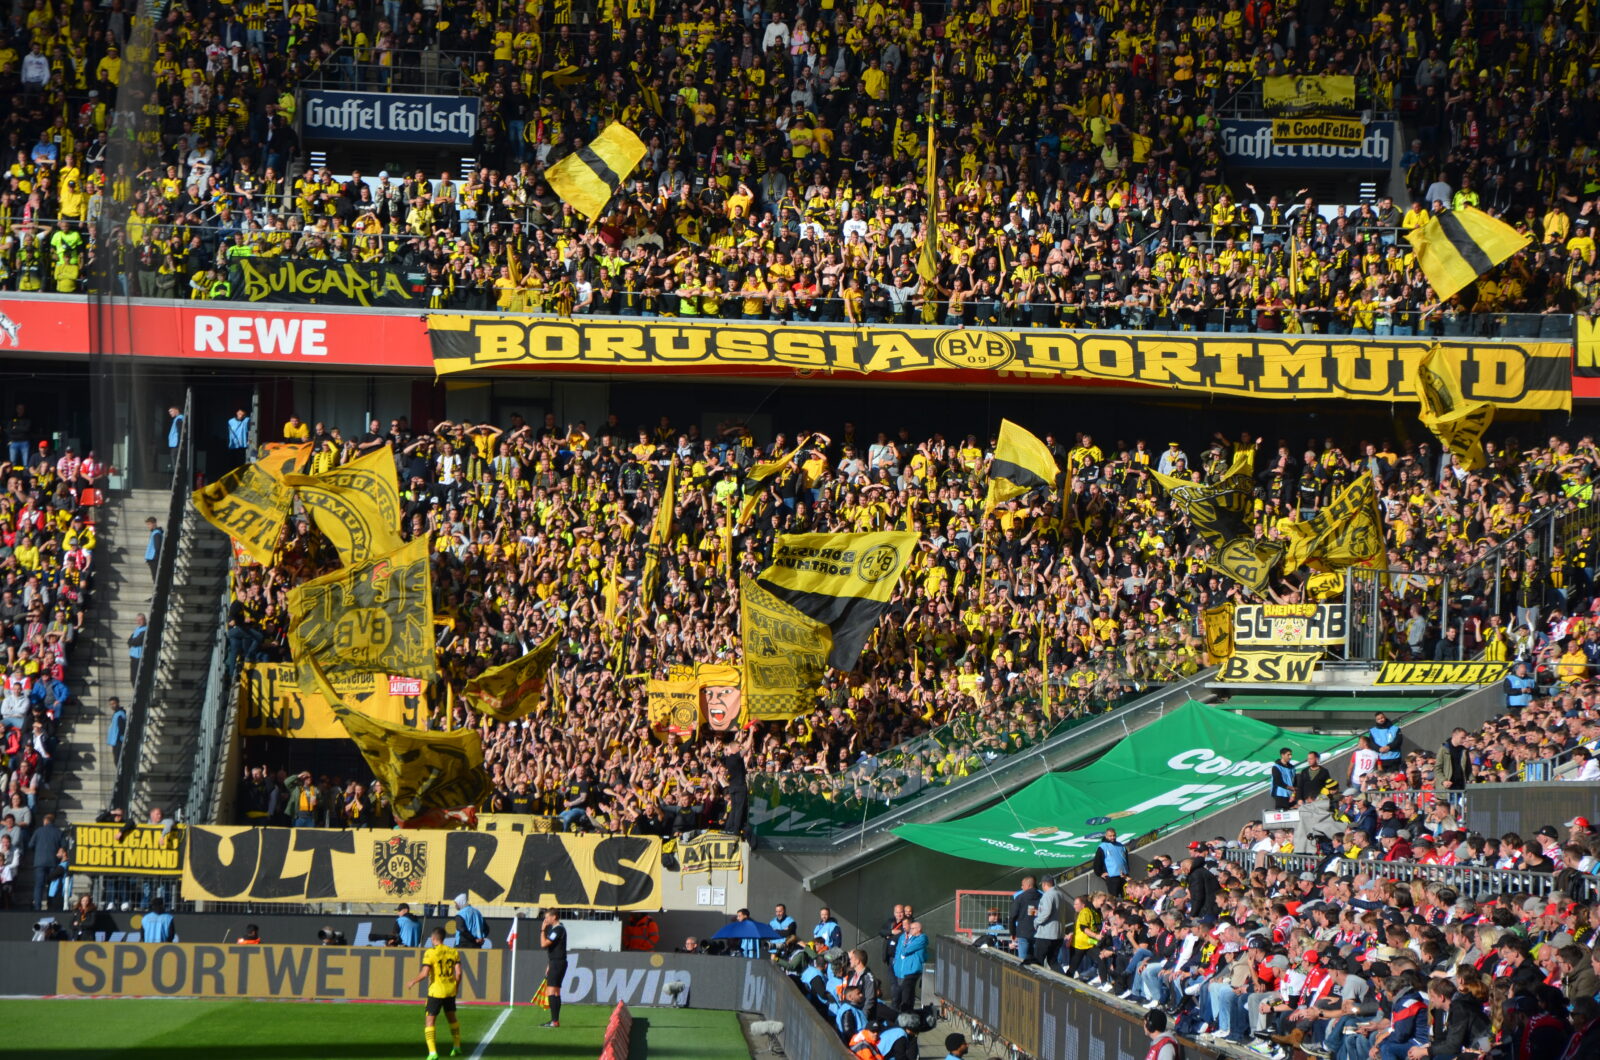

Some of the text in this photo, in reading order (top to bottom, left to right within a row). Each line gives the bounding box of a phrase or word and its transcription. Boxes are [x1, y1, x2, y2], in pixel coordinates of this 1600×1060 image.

[307, 98, 475, 138] Gaffel Kölsch
[1294, 122, 1362, 138] GoodFellas
[194, 316, 328, 356] REWE
[949, 333, 1005, 357] BVB
[473, 321, 1527, 399] BORUSSIA DORTMUND
[967, 356, 987, 364] 09
[1236, 606, 1273, 639] SG
[1223, 655, 1318, 682] BSW
[1383, 662, 1503, 684] WEIMAR
[75, 846, 179, 869] DORTMUND
[391, 857, 411, 872] BVB
[72, 944, 488, 1001] SPORTWETTN
[437, 957, 455, 978] 13
[560, 952, 692, 1006] bwin
